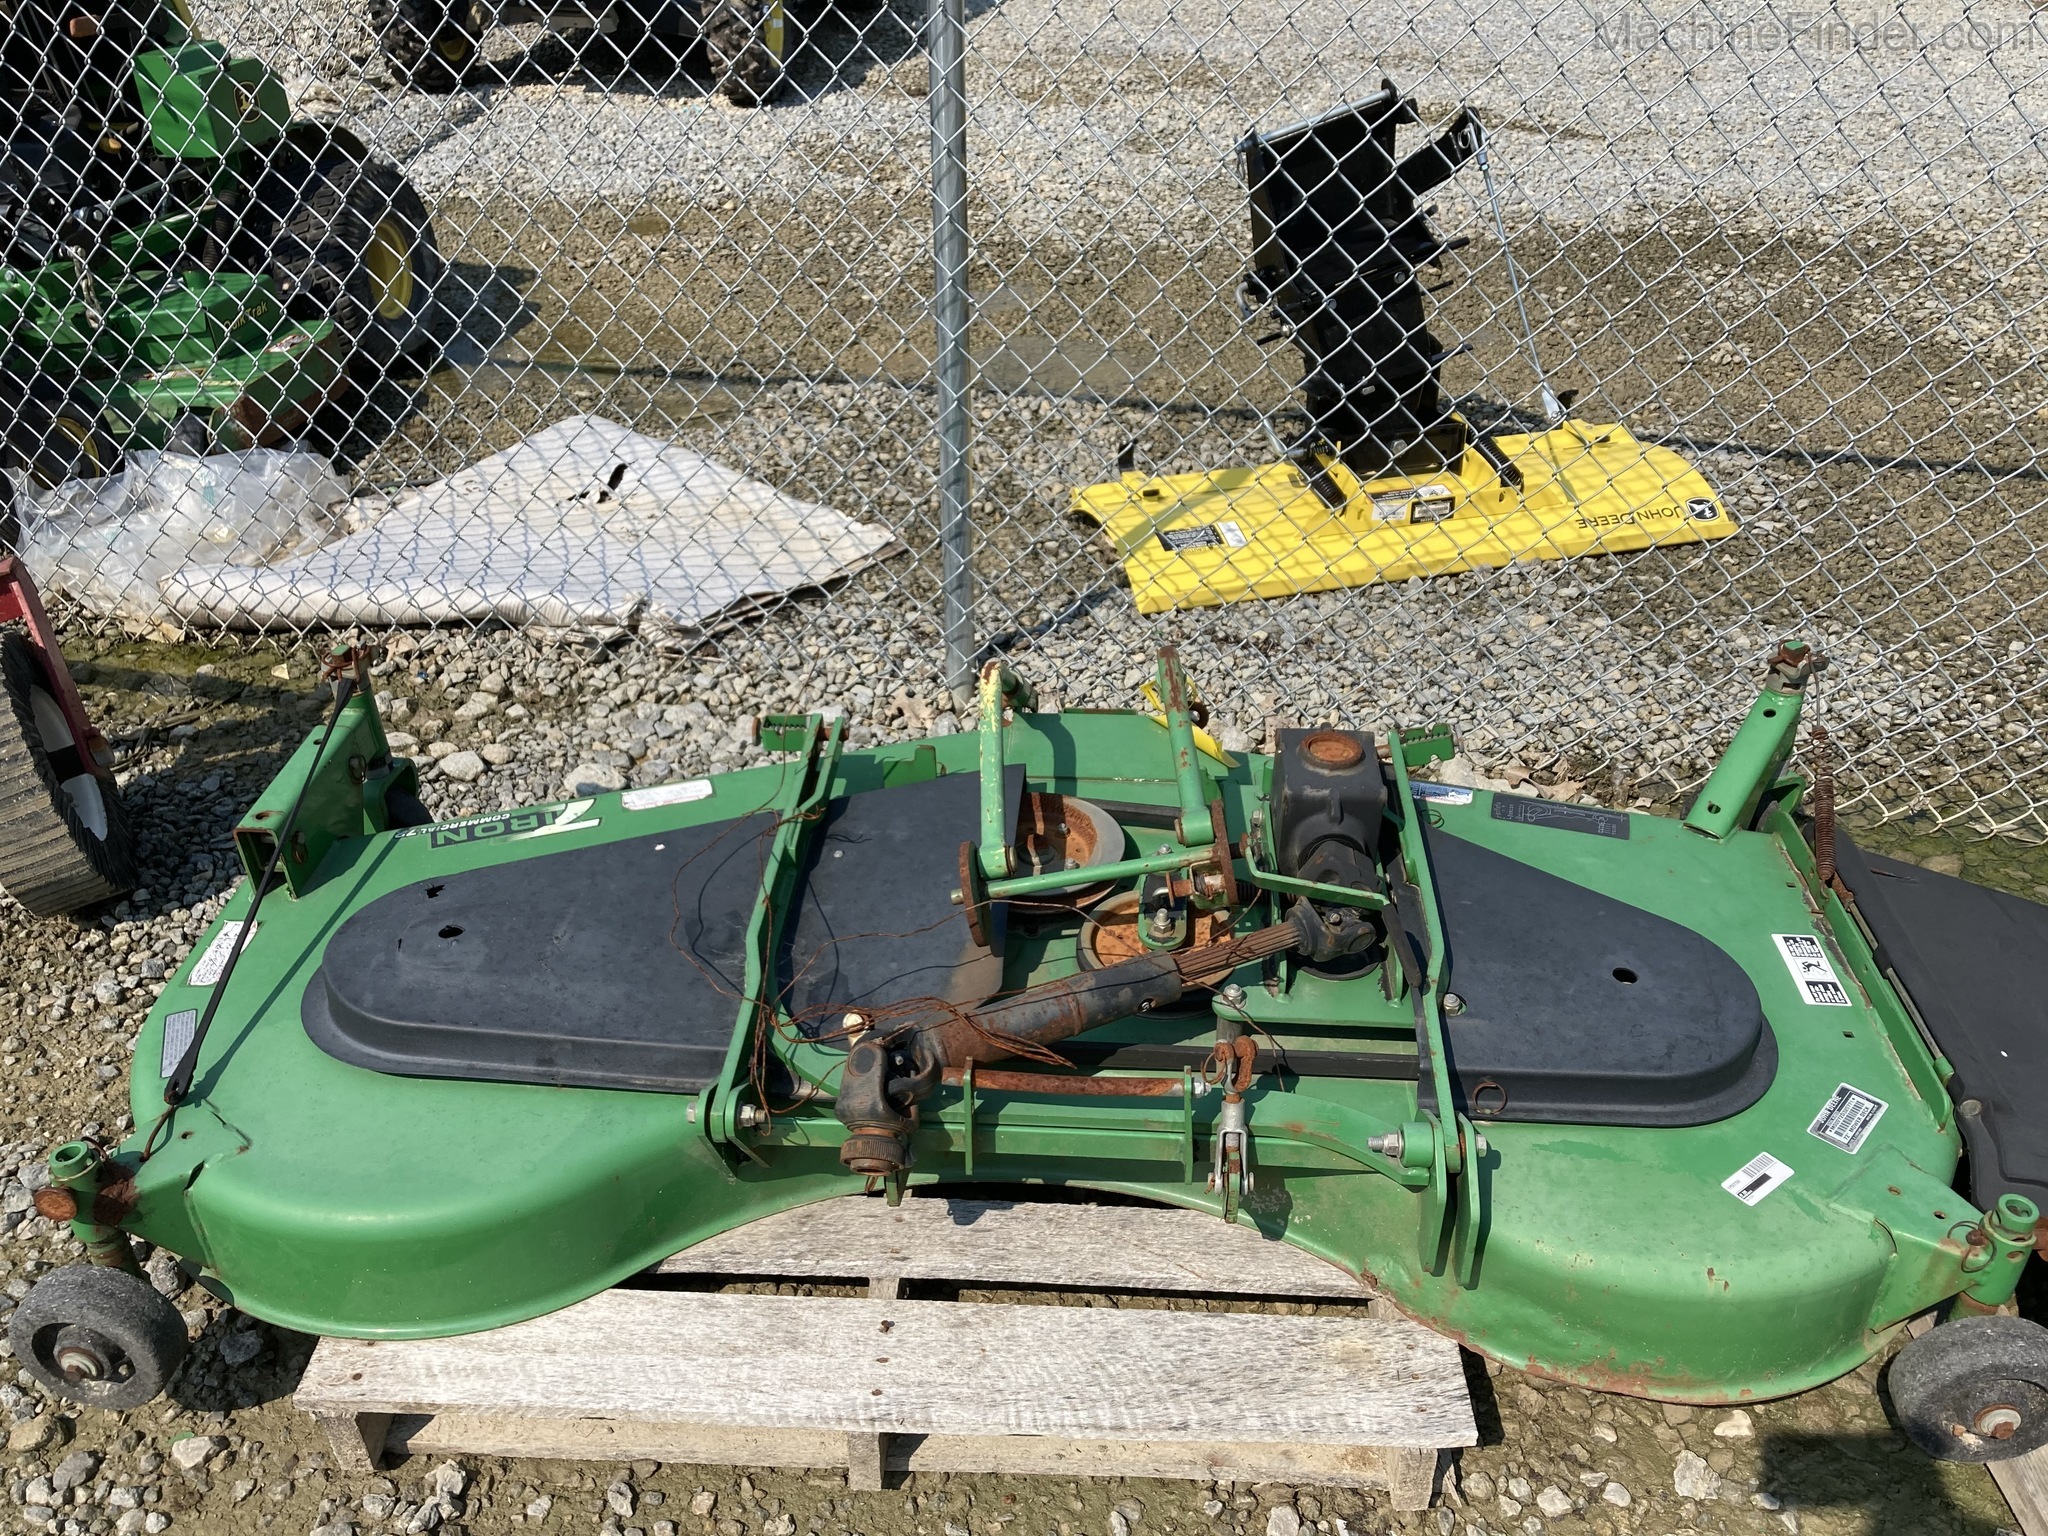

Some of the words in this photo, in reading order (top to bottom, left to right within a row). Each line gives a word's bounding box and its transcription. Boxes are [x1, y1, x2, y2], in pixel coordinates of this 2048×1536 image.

[1575, 512, 1635, 529] DEERE
[1636, 505, 1681, 521] JOHN
[420, 813, 511, 834] COMMERCIAL
[1848, 1116, 1862, 1133] MOWER
